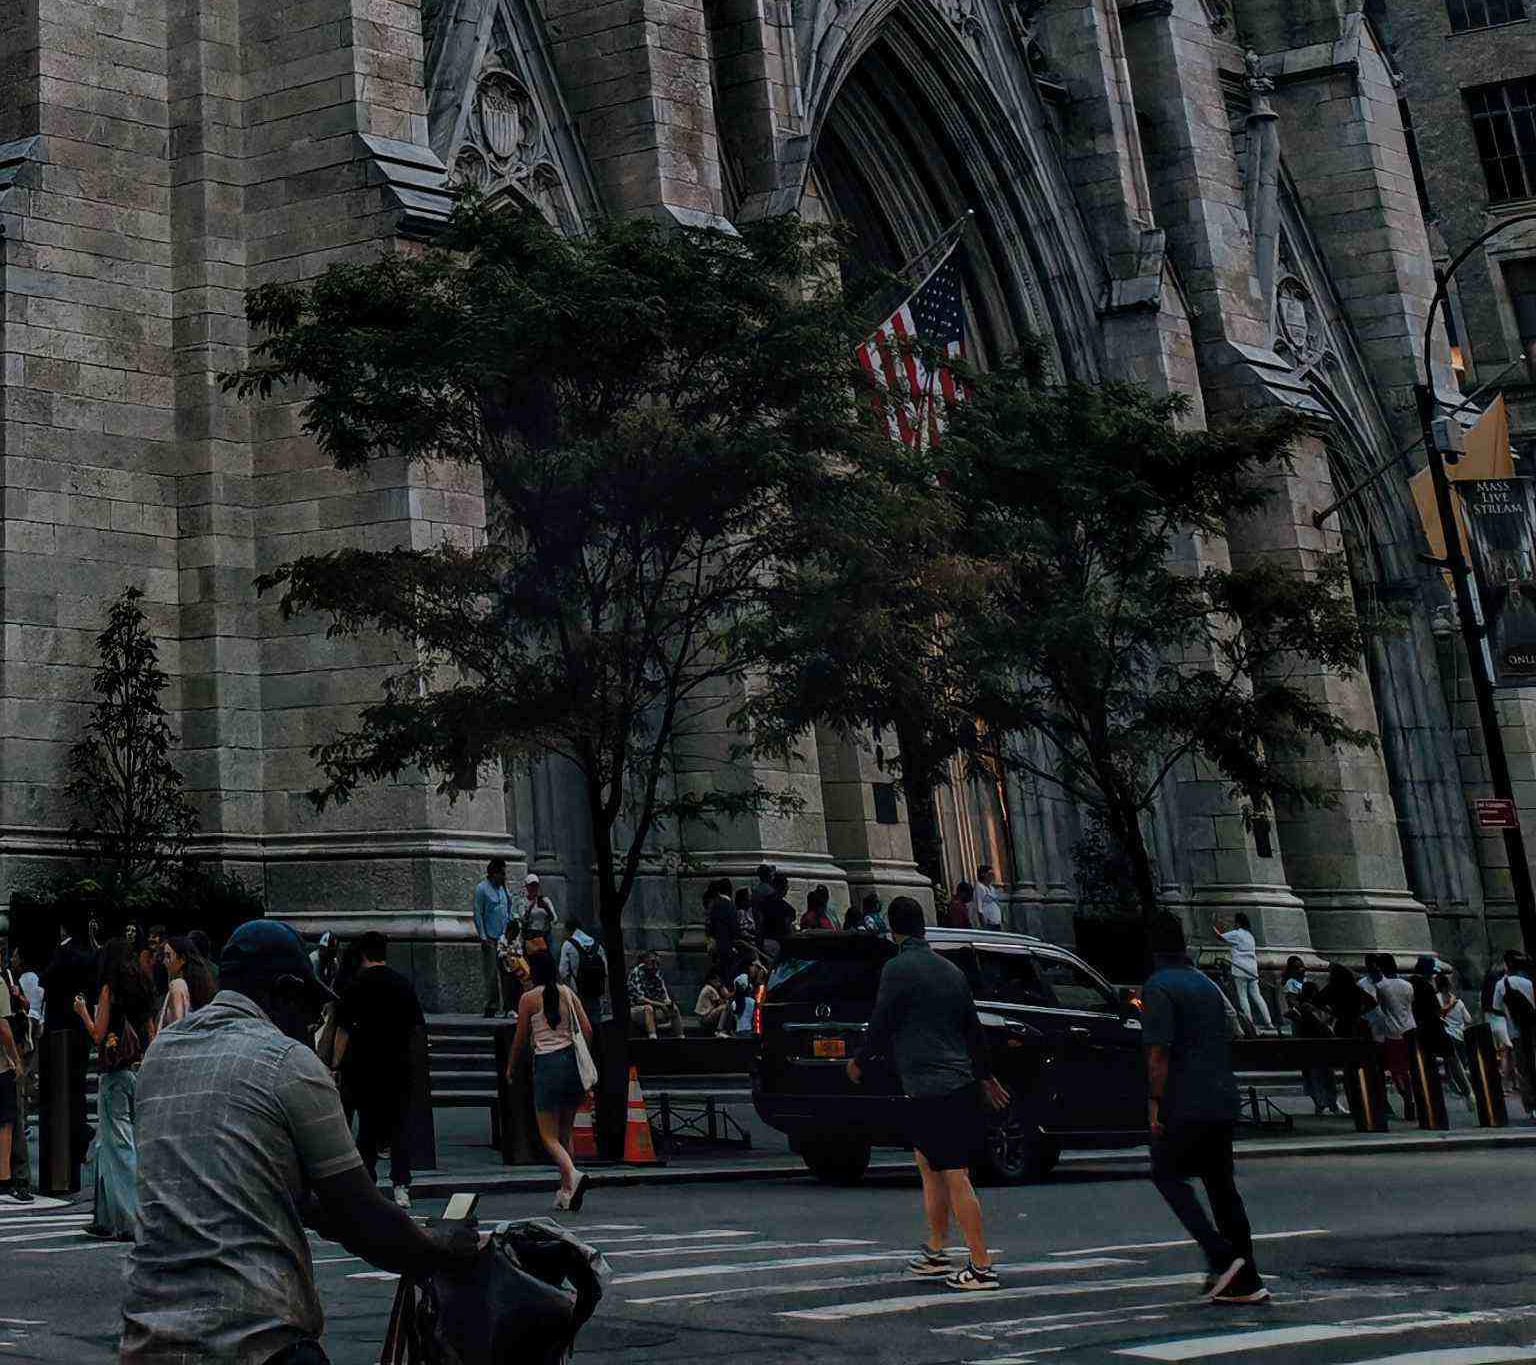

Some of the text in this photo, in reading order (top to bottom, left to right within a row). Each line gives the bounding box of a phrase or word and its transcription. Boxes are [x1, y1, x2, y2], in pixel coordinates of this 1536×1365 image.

[1476, 481, 1510, 492] MASS
[1481, 492, 1508, 503] LIVE
[1473, 503, 1523, 515] STREAM
[1508, 655, 1536, 665] ONLI
